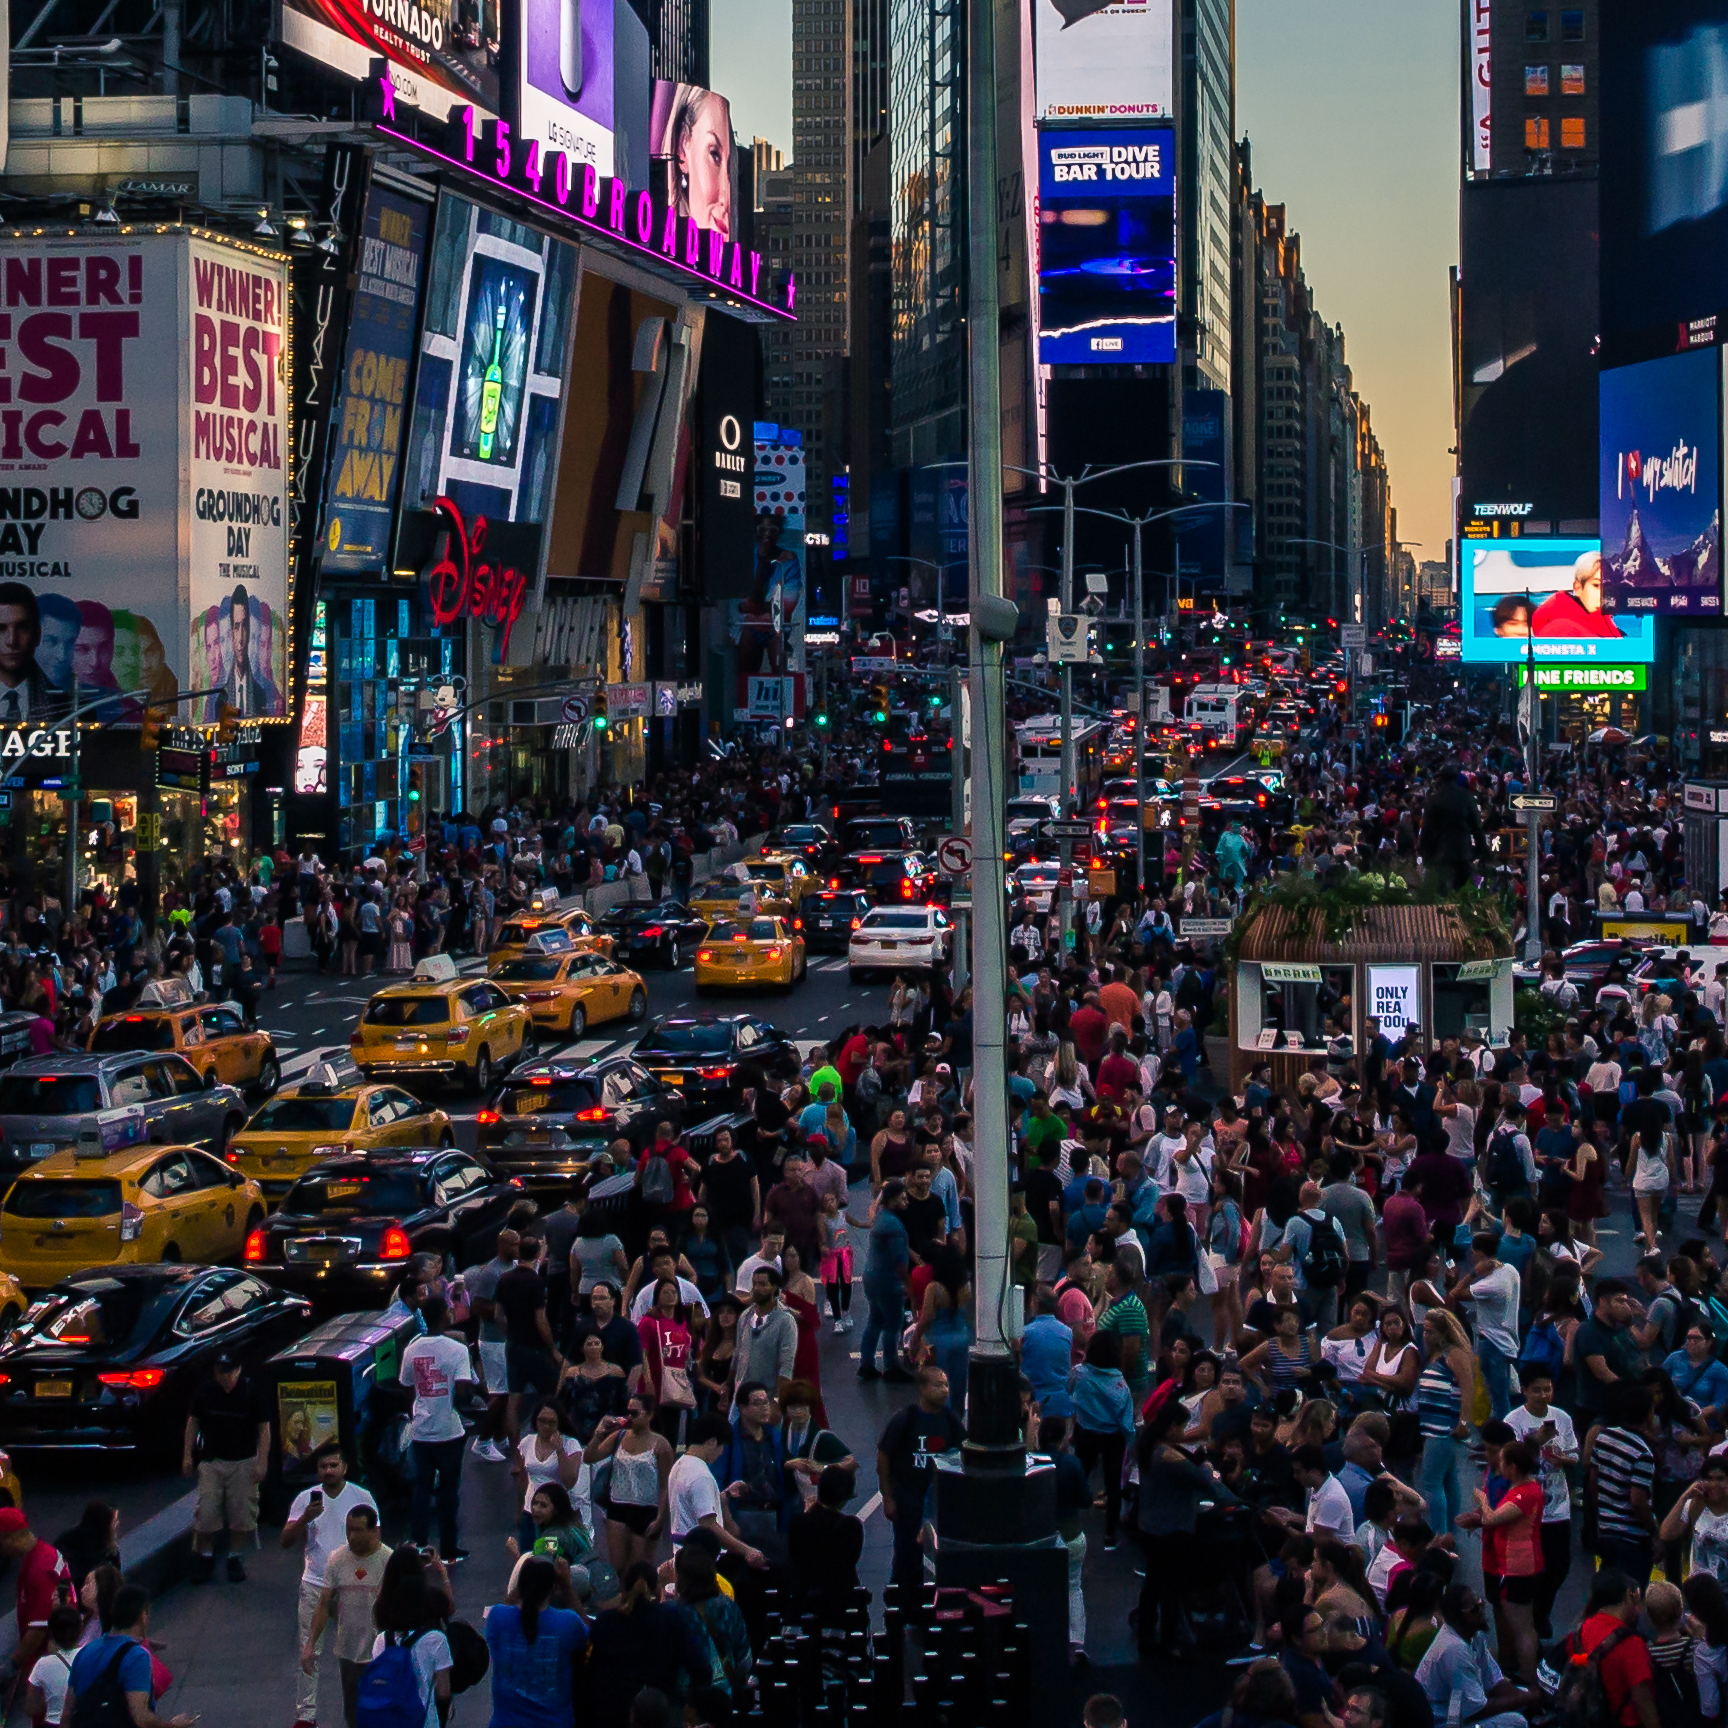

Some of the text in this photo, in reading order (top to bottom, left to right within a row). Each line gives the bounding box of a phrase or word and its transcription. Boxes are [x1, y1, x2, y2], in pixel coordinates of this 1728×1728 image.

[373, 23, 432, 65] REALTY TRUST
[1057, 104, 1158, 115] DUNKIN' DONUTS
[548, 119, 597, 162] LG SIGNATURE
[1057, 146, 1160, 162] BUD LIGHT DIVE
[126, 180, 190, 194] LAMAR
[1055, 162, 1160, 182] BAR TOUR
[463, 104, 761, 296] 1540 BROADWAY
[194, 257, 283, 327] WINNER!
[195, 313, 281, 418] BEST
[349, 348, 408, 405] COME
[195, 409, 281, 471] MUSICAL
[342, 396, 401, 457] FROM
[335, 449, 397, 502] AWAY
[715, 451, 745, 472] OAKLEY
[196, 488, 281, 528] GROUNDHOG
[227, 527, 252, 559] DAY
[218, 562, 261, 580] THE MUSICAL
[430, 495, 526, 664] Disney
[1564, 669, 1635, 685] FRIENDS
[1376, 986, 1409, 1000] ONLY
[279, 1383, 335, 1401] Beautiful
